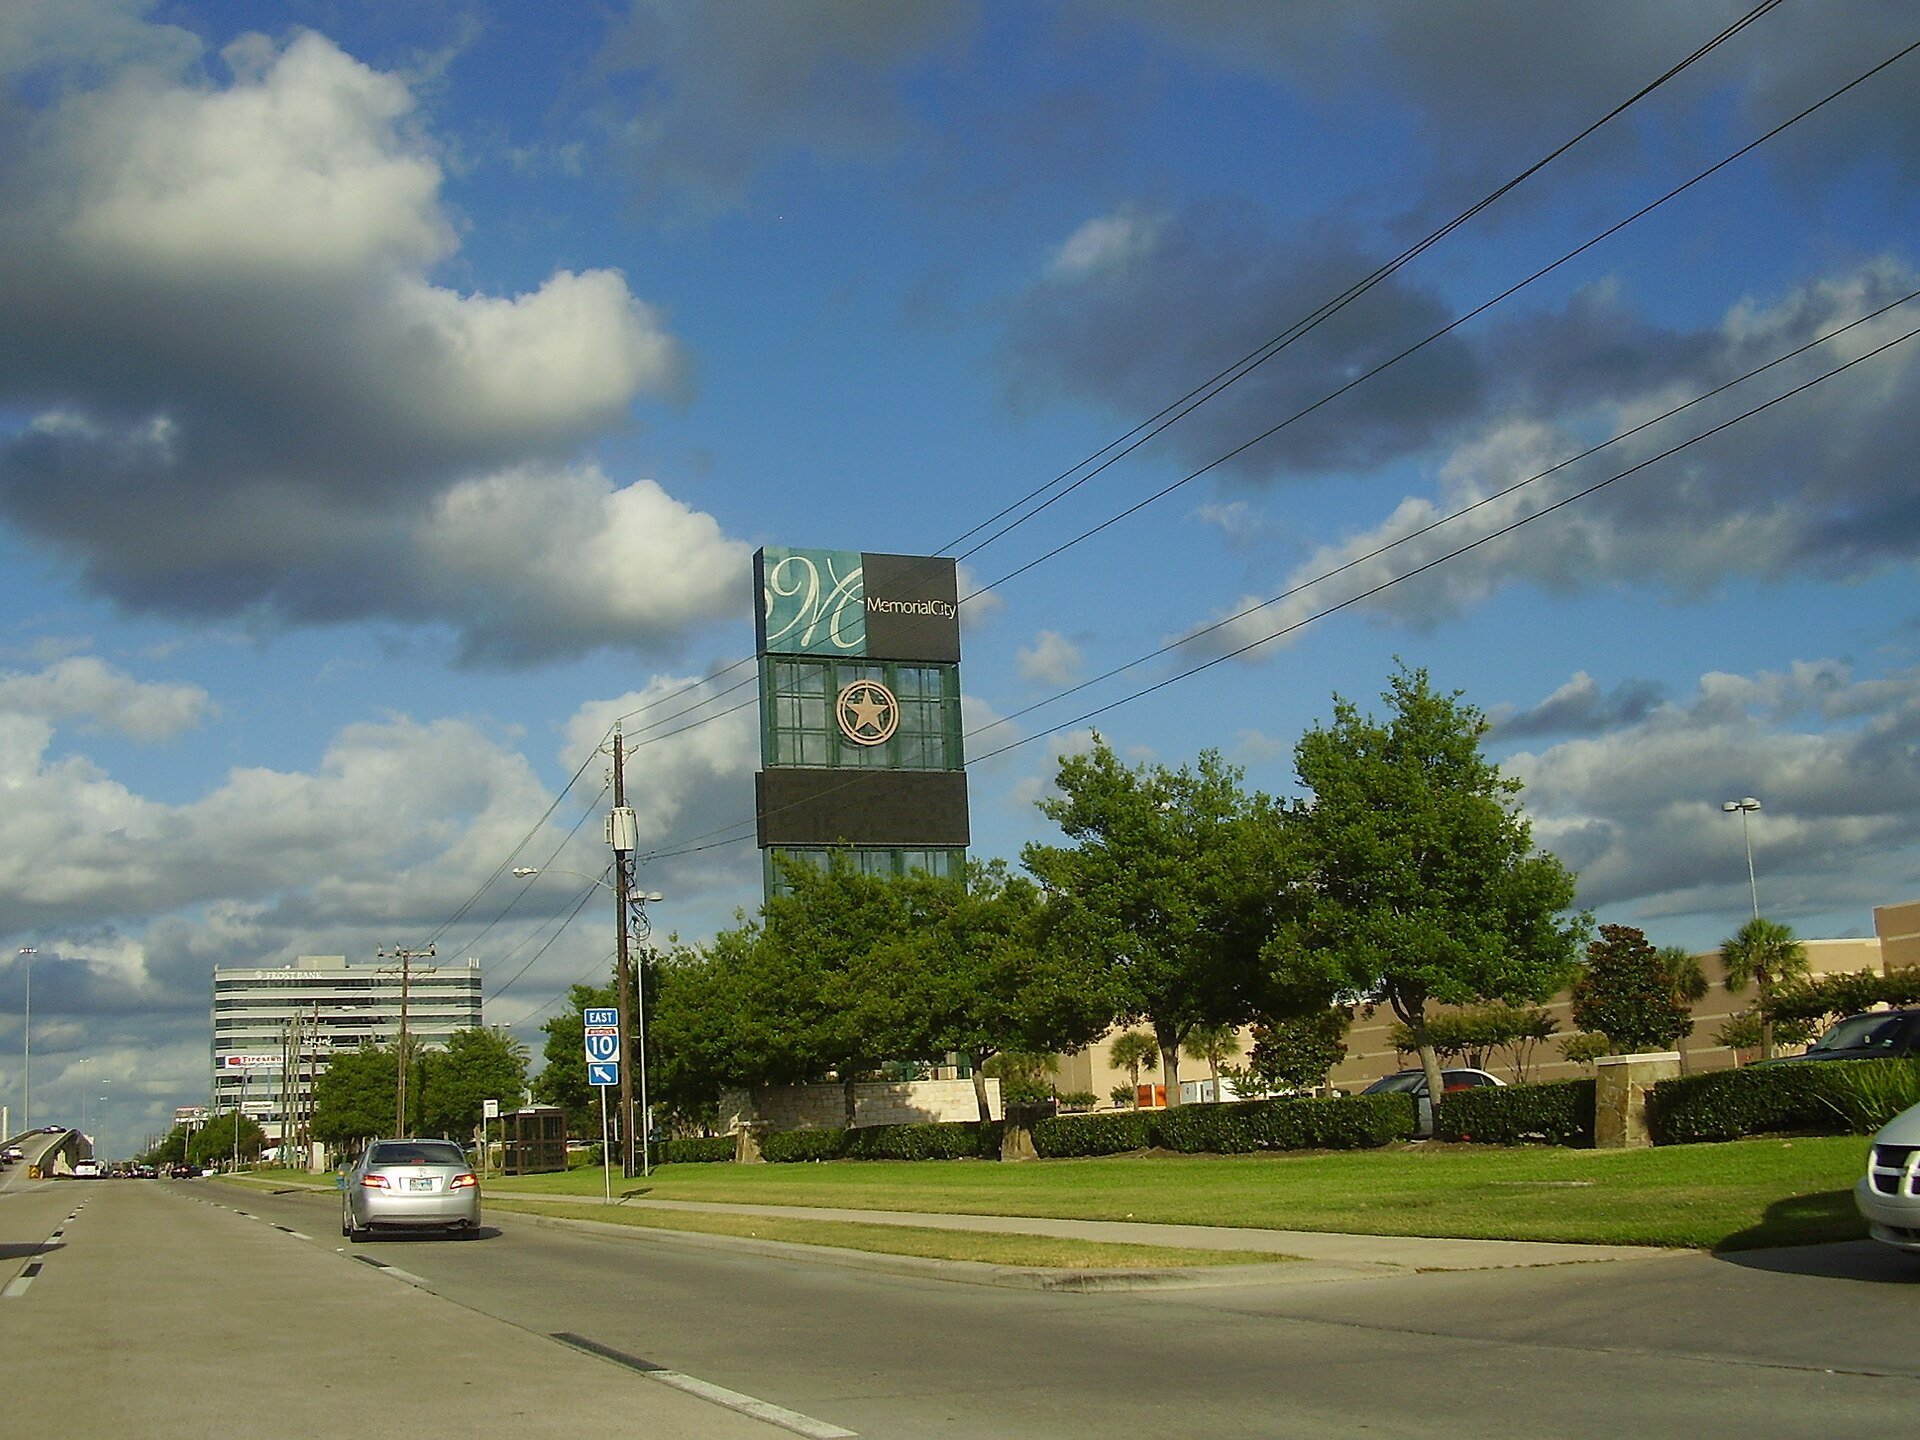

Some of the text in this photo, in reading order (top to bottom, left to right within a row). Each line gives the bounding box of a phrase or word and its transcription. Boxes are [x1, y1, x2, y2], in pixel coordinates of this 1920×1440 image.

[867, 596, 957, 620] MemorialCity
[589, 1012, 613, 1024] EAST
[591, 1035, 613, 1055] 10
